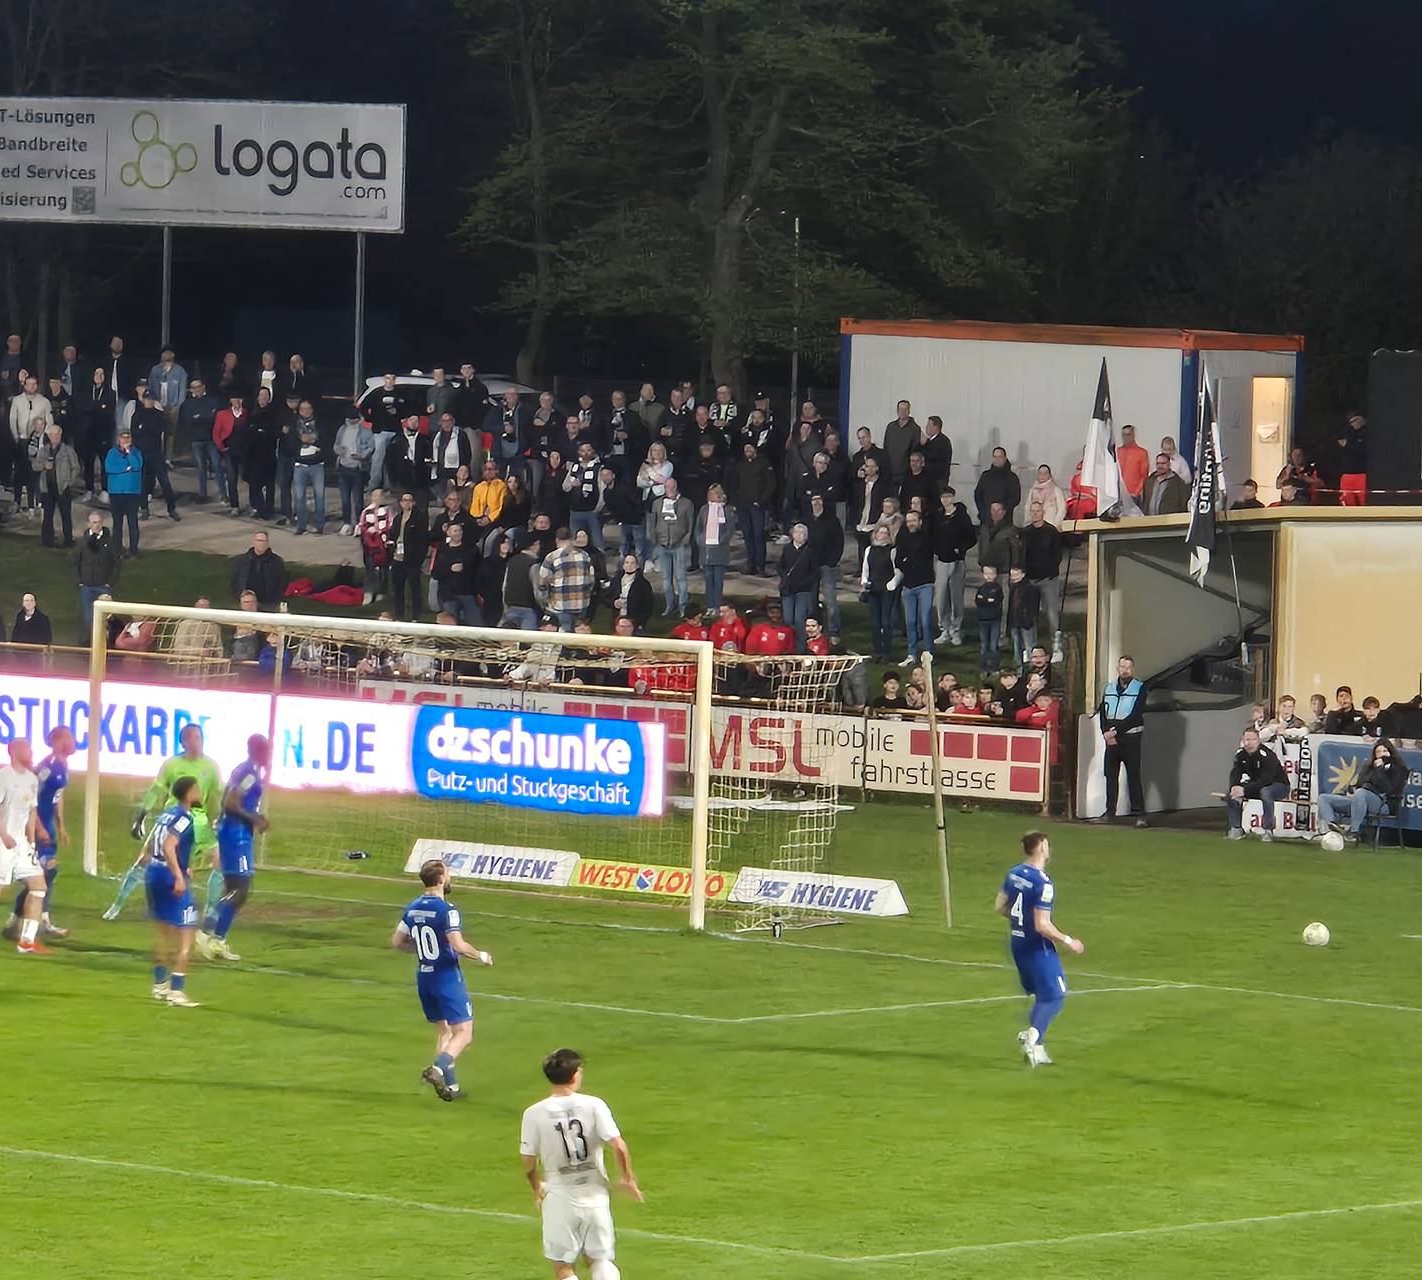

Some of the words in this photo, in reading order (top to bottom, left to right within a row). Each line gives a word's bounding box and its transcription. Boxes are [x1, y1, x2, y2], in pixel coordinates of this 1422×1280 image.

[26, 165, 96, 181] Services
[214, 124, 387, 197] logata
[428, 712, 633, 776] dzschunke
[709, 714, 822, 777] MSL
[816, 723, 894, 752] mobile
[427, 767, 474, 791] Putz-
[475, 772, 508, 795] und
[511, 775, 632, 806] Stuckgeschäft
[470, 853, 558, 880] HYGIENE
[578, 863, 639, 889] WEST
[652, 869, 724, 897] LOTO
[789, 882, 878, 912] HYGIENE
[1010, 892, 1024, 926] 4
[411, 925, 440, 961] 10
[554, 1119, 588, 1162] 13
